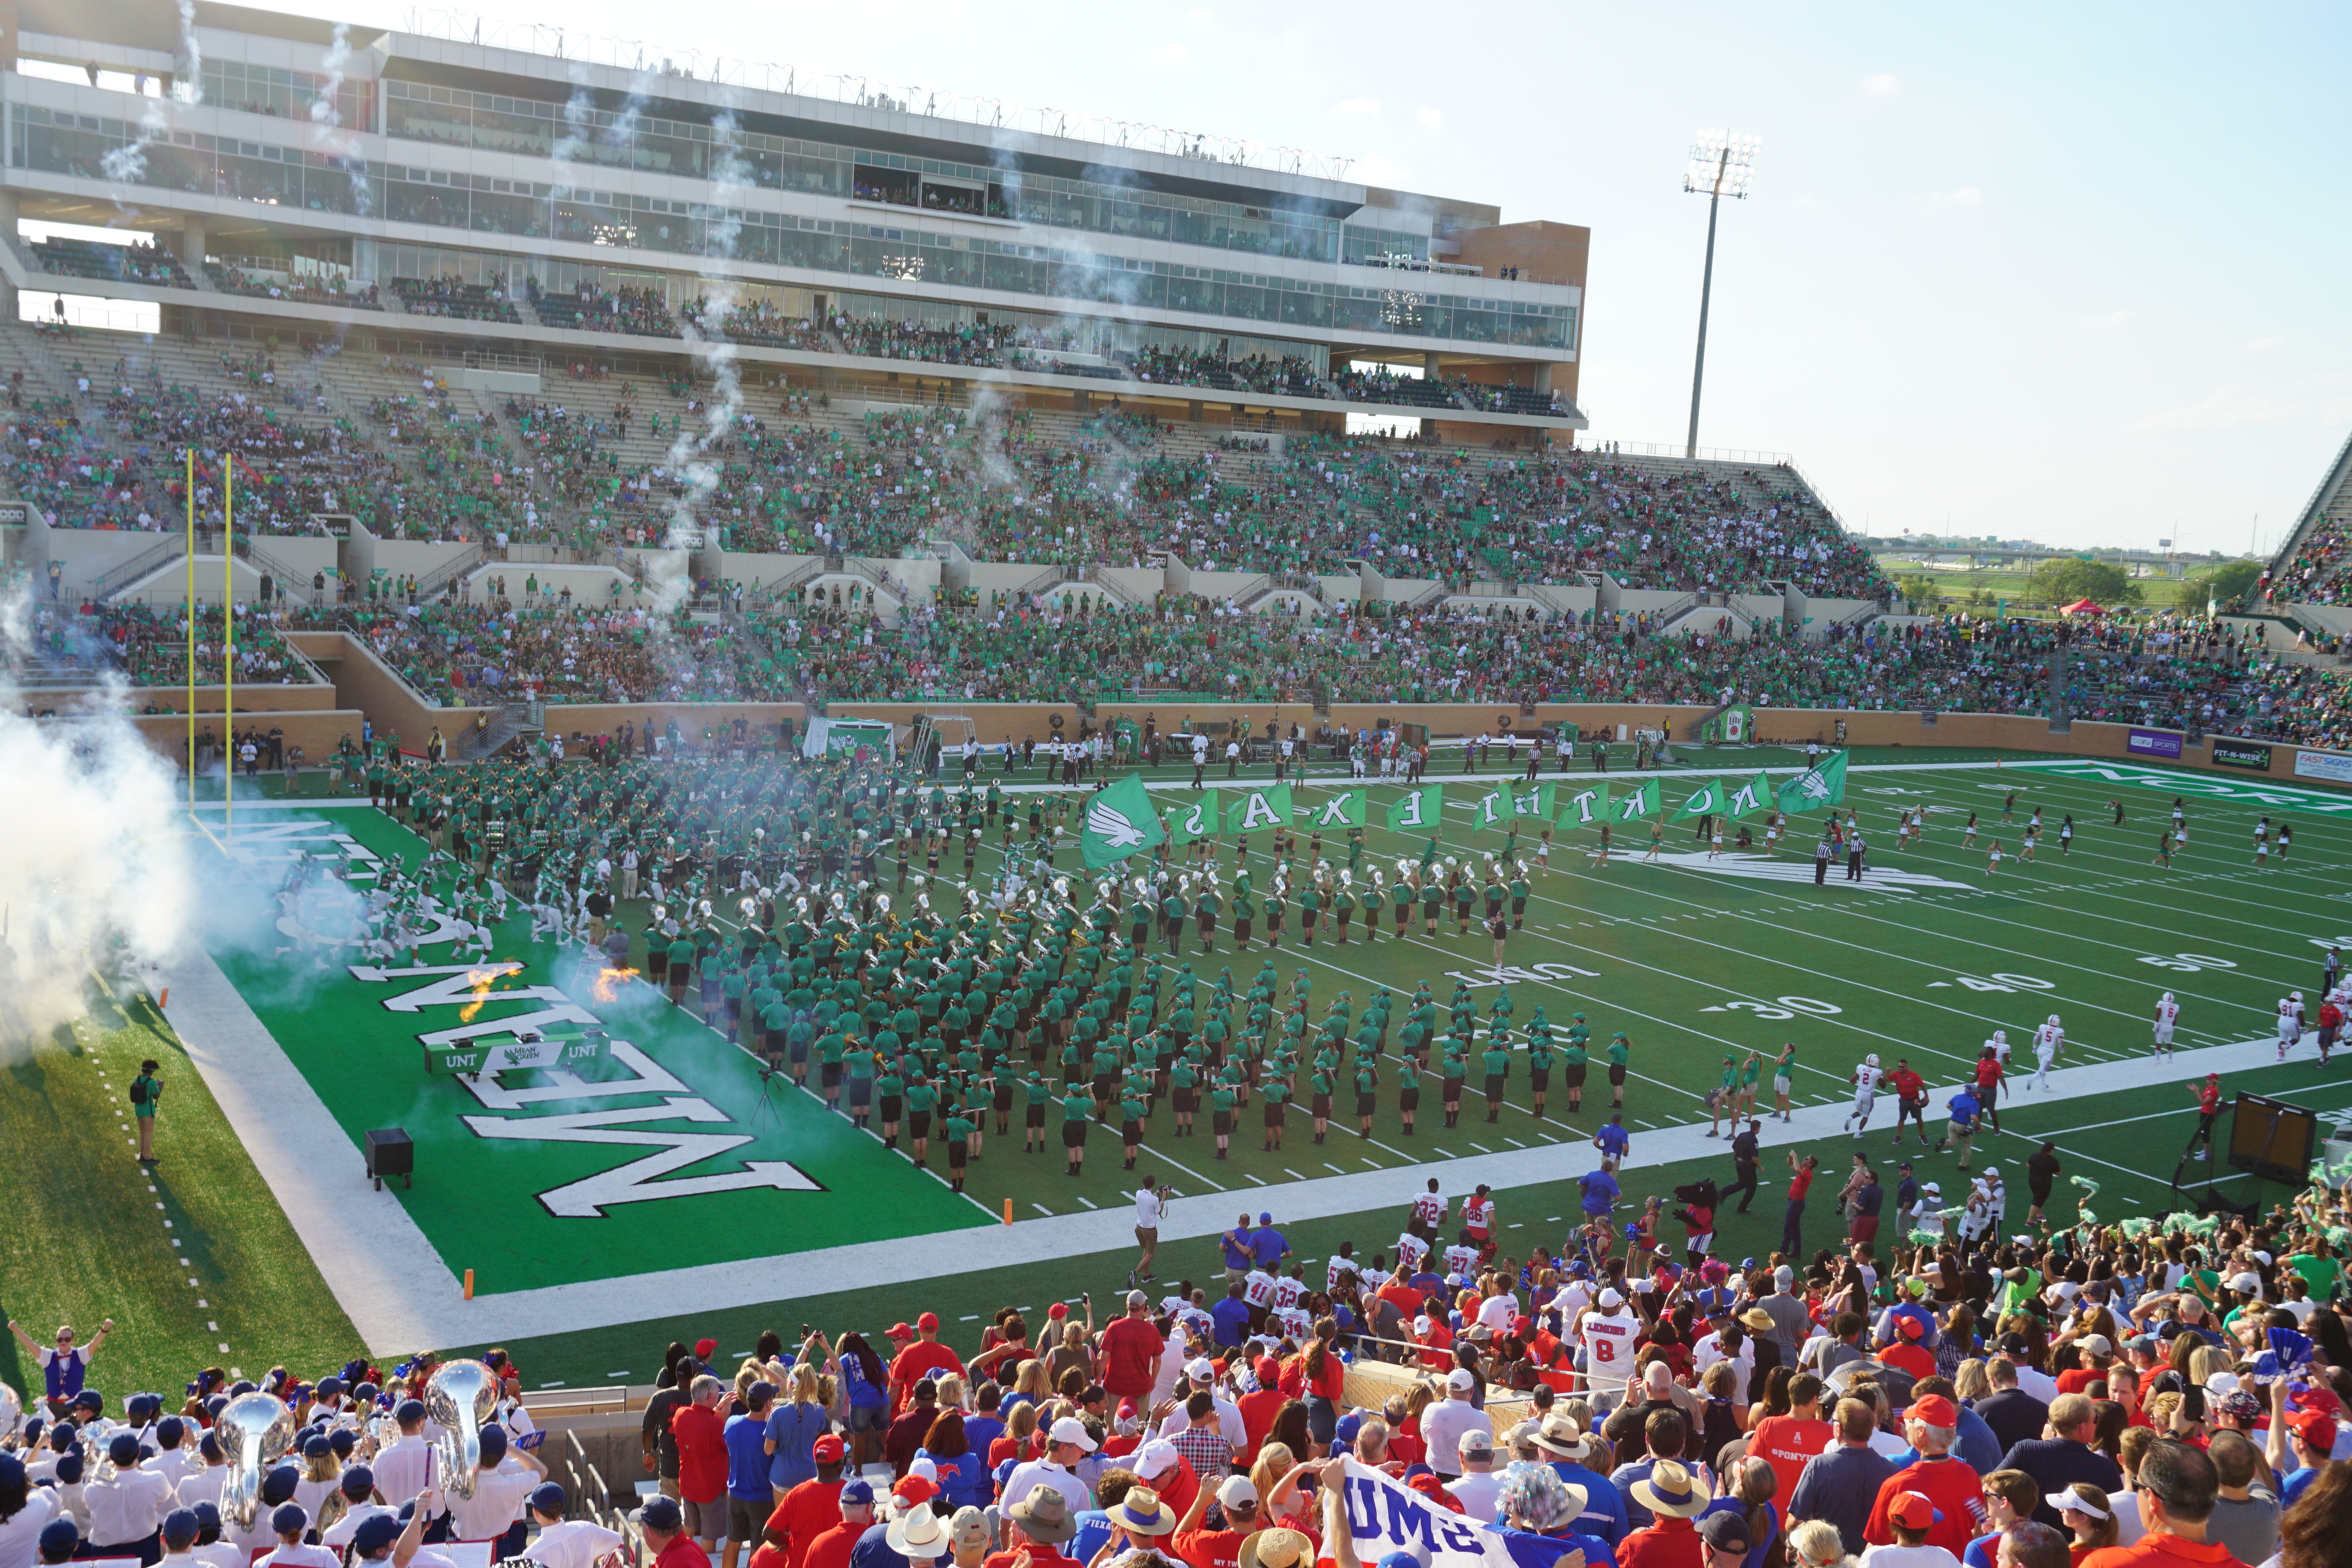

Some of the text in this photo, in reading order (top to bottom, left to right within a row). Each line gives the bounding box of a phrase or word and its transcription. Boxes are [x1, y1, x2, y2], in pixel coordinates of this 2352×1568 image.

[1729, 716, 1742, 725] Lite
[2153, 741, 2177, 750] SPORTS
[2214, 749, 2261, 762] FIT-N-WISE
[2136, 953, 2238, 972] 50
[1955, 973, 2056, 993] 40
[1726, 996, 1843, 1019] 30
[2168, 1007, 2174, 1018] 6
[2281, 1004, 2293, 1017] 91
[2045, 1031, 2052, 1042] 5
[514, 1046, 536, 1055] MEAN
[516, 1052, 540, 1060] GREEN
[568, 1044, 598, 1058] UNT
[446, 1053, 477, 1068] UNT
[1863, 1072, 1869, 1085] 2
[1419, 1201, 1438, 1221] 32
[1400, 1242, 1416, 1265] 36
[1452, 1256, 1468, 1274] 27
[1250, 1282, 1268, 1303] 41
[1276, 1286, 1297, 1308] 32
[1506, 1310, 1516, 1329] 3
[1285, 1319, 1303, 1338] 34
[1595, 1339, 1615, 1362] 8
[1771, 1448, 1814, 1462] #PONYU
[1085, 1518, 1112, 1531] #TEXA
[1214, 1559, 1238, 1568] MY TW
